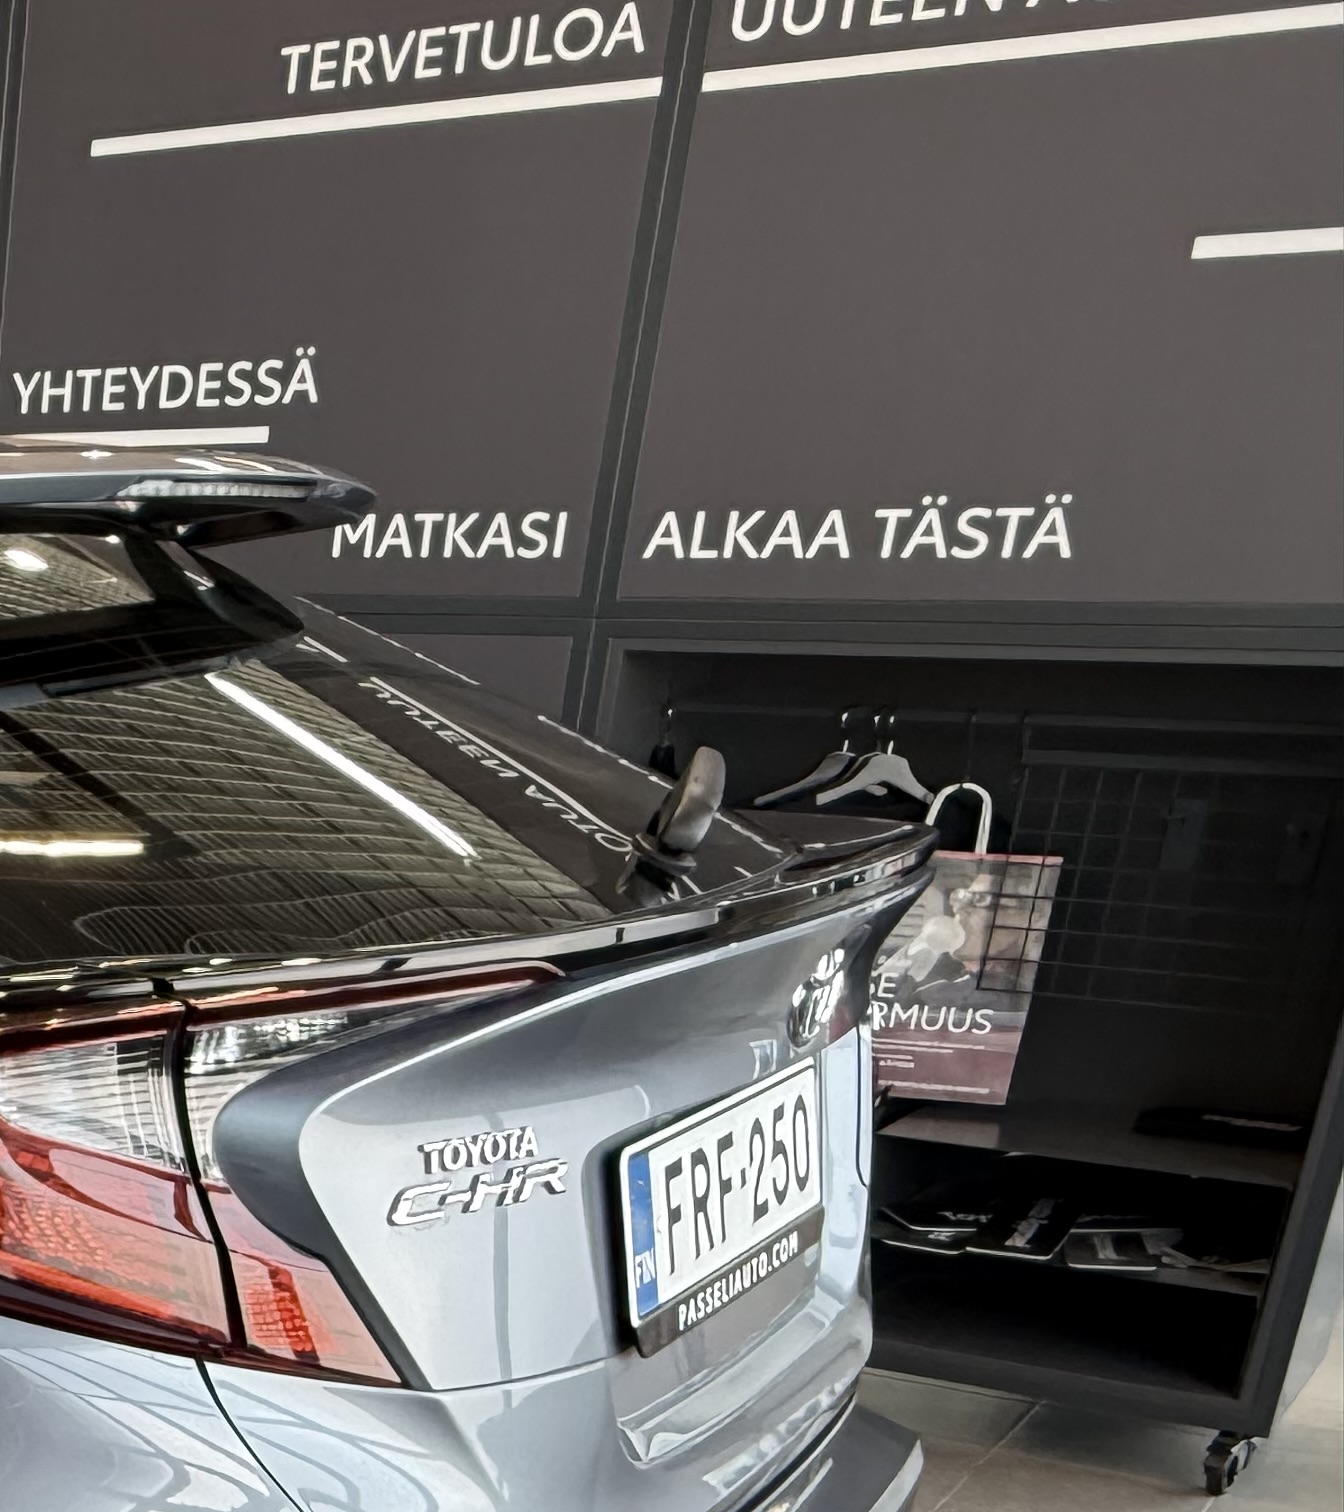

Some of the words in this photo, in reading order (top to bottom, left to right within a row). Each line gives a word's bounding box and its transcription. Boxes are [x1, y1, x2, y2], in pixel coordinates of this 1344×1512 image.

[280, 2, 645, 95] TERVETULOA
[12, 346, 318, 415] YHTEYDESSÄ
[331, 511, 568, 559] MATKASI
[642, 509, 850, 559] ALKAA
[874, 493, 1073, 559] TÄSTÄ
[867, 1000, 994, 1035] RMUUS
[417, 1125, 539, 1175] TOYOTA
[386, 1157, 569, 1227] C-HR
[664, 1093, 810, 1277] FRF-250
[634, 1248, 658, 1289] FIN
[678, 1230, 799, 1332] PASSELIAUTO.COM
